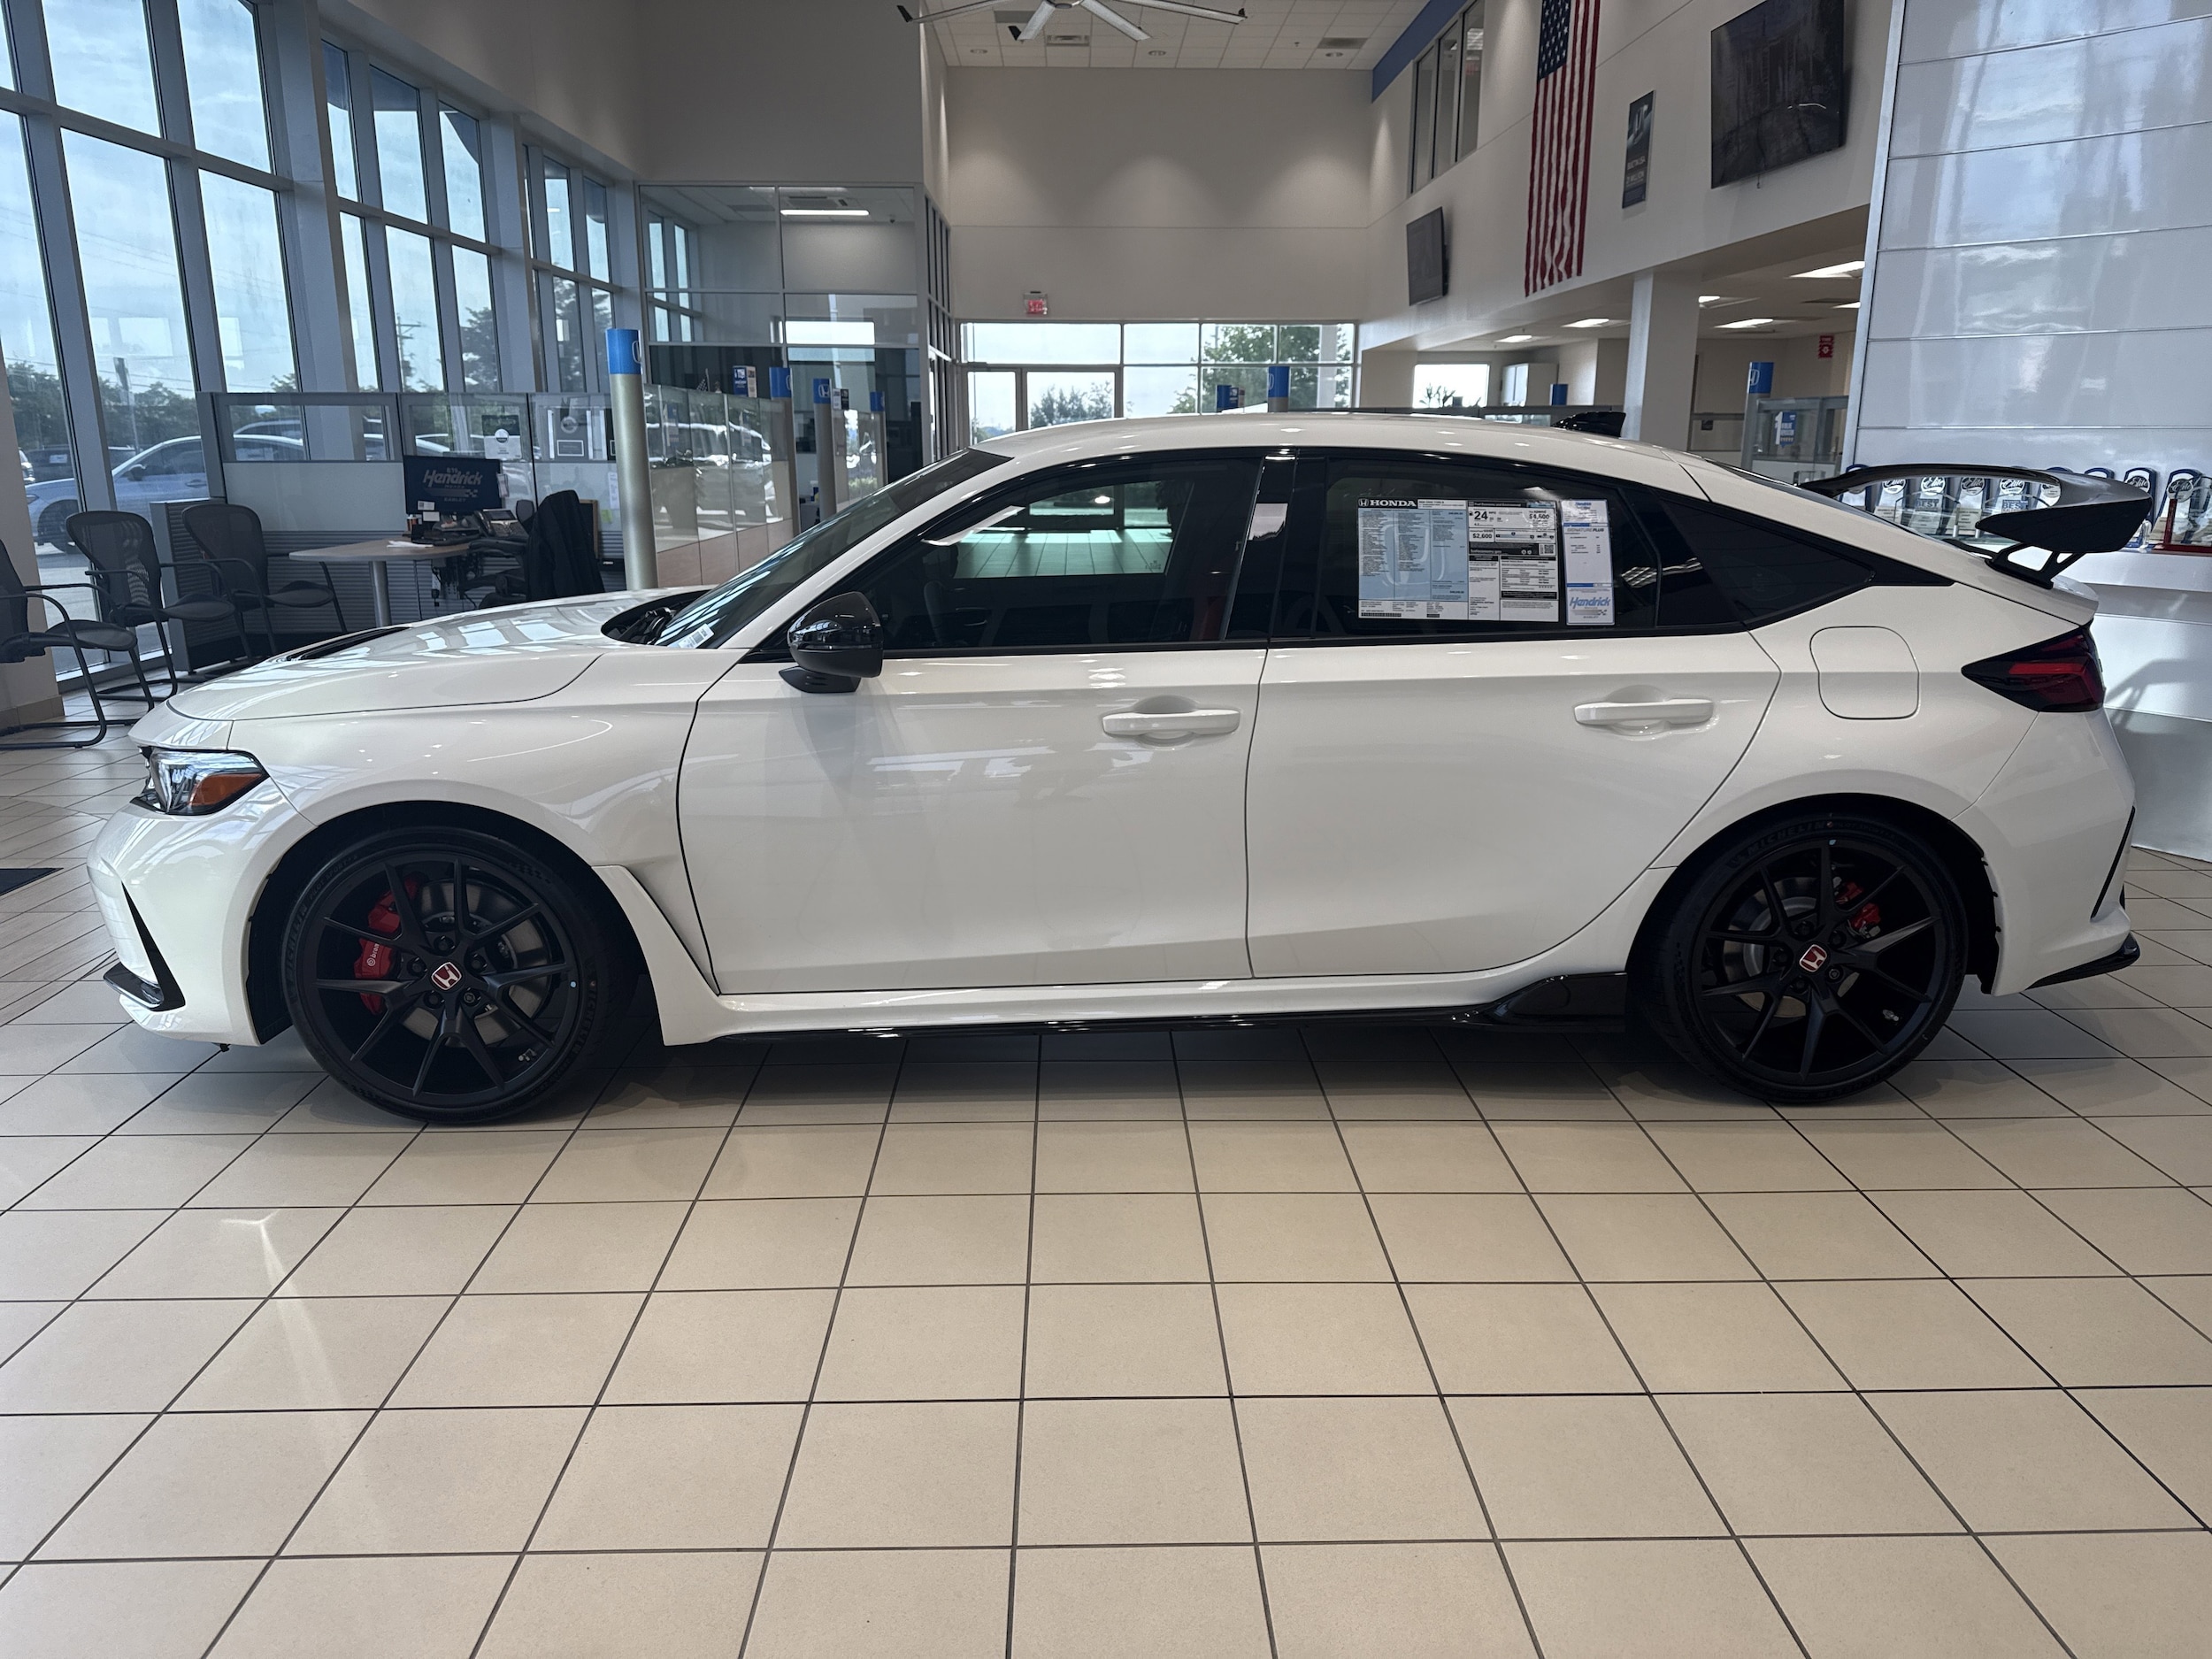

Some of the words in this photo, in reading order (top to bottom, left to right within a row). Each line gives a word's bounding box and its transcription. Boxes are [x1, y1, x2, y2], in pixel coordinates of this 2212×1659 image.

[423, 470, 483, 488] Hendrick
[1474, 511, 1488, 520] 24
[1570, 596, 1611, 609] Hendrick
[1747, 820, 1825, 855] MICHELIN
